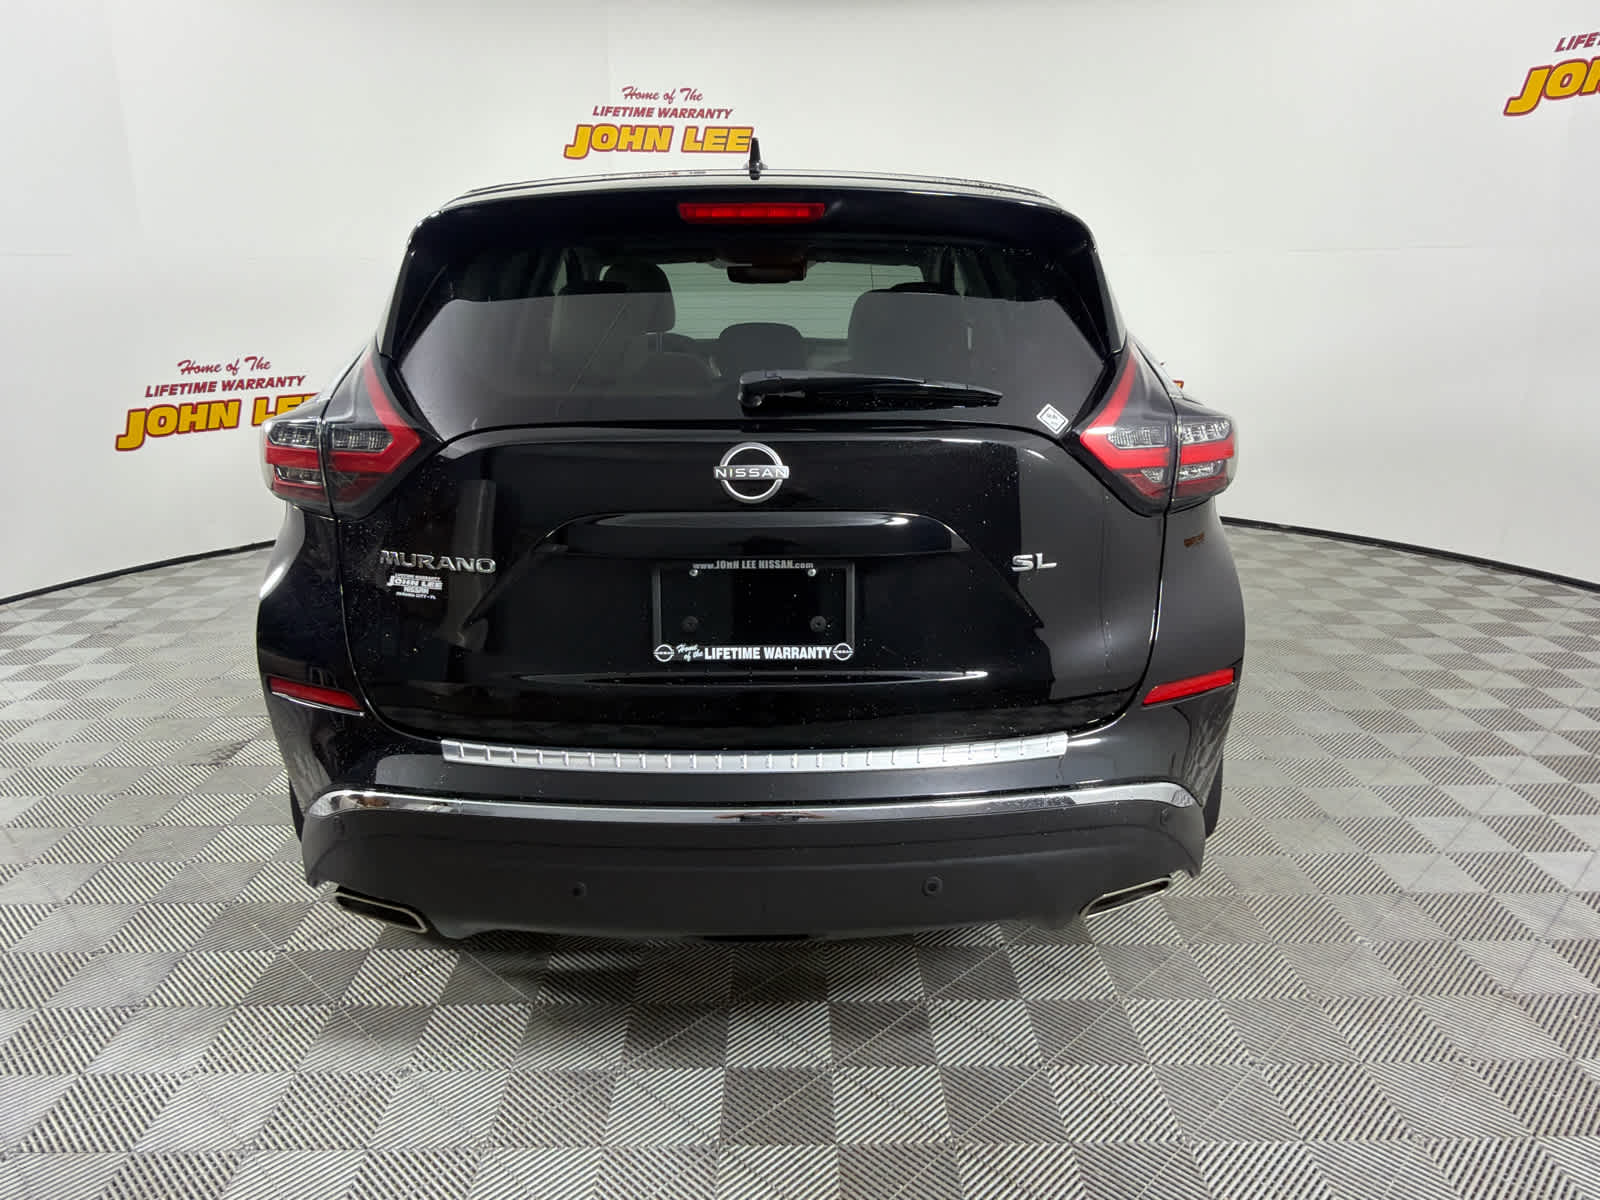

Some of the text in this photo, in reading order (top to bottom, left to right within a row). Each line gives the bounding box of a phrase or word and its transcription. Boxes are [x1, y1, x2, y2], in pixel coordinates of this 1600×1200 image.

[622, 86, 703, 104] Home of The
[592, 105, 733, 119] LIFETIME WARRANTY
[563, 123, 754, 160] JOHN LEE
[177, 356, 271, 376] Home of The
[145, 375, 306, 398] LIFETIME WARRANTY
[115, 392, 320, 451] JOHN LE
[715, 467, 788, 479] NISSAN
[380, 550, 497, 574] MURANO
[741, 560, 757, 569] LEE
[1011, 552, 1057, 572] SL
[704, 647, 761, 660] LIFETIME
[763, 646, 833, 660] WARRANTY
